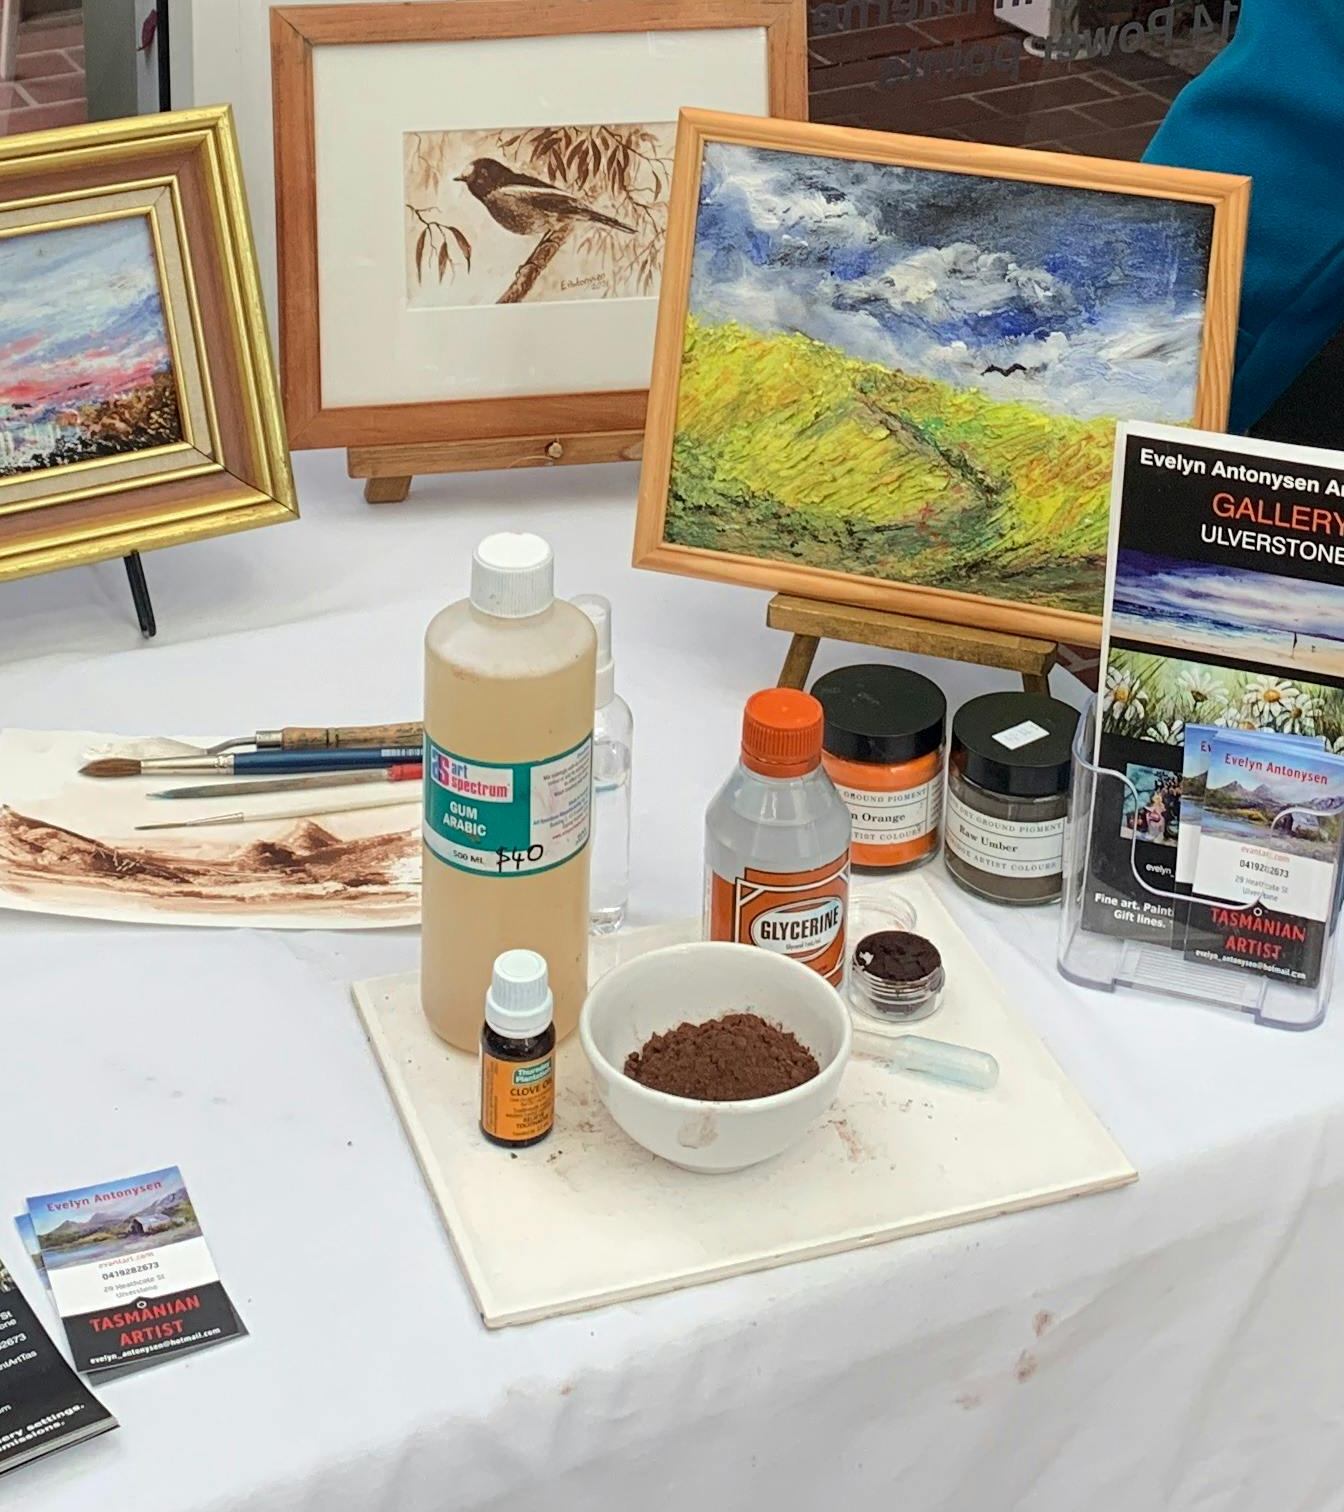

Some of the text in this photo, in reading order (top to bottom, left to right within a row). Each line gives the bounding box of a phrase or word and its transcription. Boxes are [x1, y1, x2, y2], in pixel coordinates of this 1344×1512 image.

[1140, 447, 1206, 477] Evelyn
[1211, 459, 1320, 494] Antonysen
[451, 763, 468, 778] art
[1224, 753, 1329, 785] Evelyn Antonysen
[451, 775, 508, 798] spectrum
[843, 789, 926, 803] GROUND PIGMENT
[449, 801, 478, 820] GUM
[862, 812, 906, 824] Orange
[442, 813, 487, 837] ARABIC
[854, 831, 876, 841] TIST
[976, 816, 1016, 832] GROUND
[1019, 822, 1062, 833] PIGMENT
[959, 824, 978, 841] Raw
[980, 835, 1019, 853] Umber
[452, 849, 469, 862] 500
[495, 844, 544, 873] $40
[1145, 863, 1175, 878] evelyn_
[1094, 892, 1175, 917] Fine art. Paint
[760, 905, 840, 941] GLYCERINE
[1113, 909, 1167, 929] Gift lines.
[1211, 907, 1306, 943] TASMANIAN
[1225, 935, 1283, 960] ARTIST
[46, 1180, 162, 1213] Evelyn Antonysen
[102, 1261, 160, 1281] 0419282673
[89, 1294, 201, 1333] TASMANIAN
[119, 1319, 184, 1348] ARTIST
[25, 1402, 86, 1436] settings.
